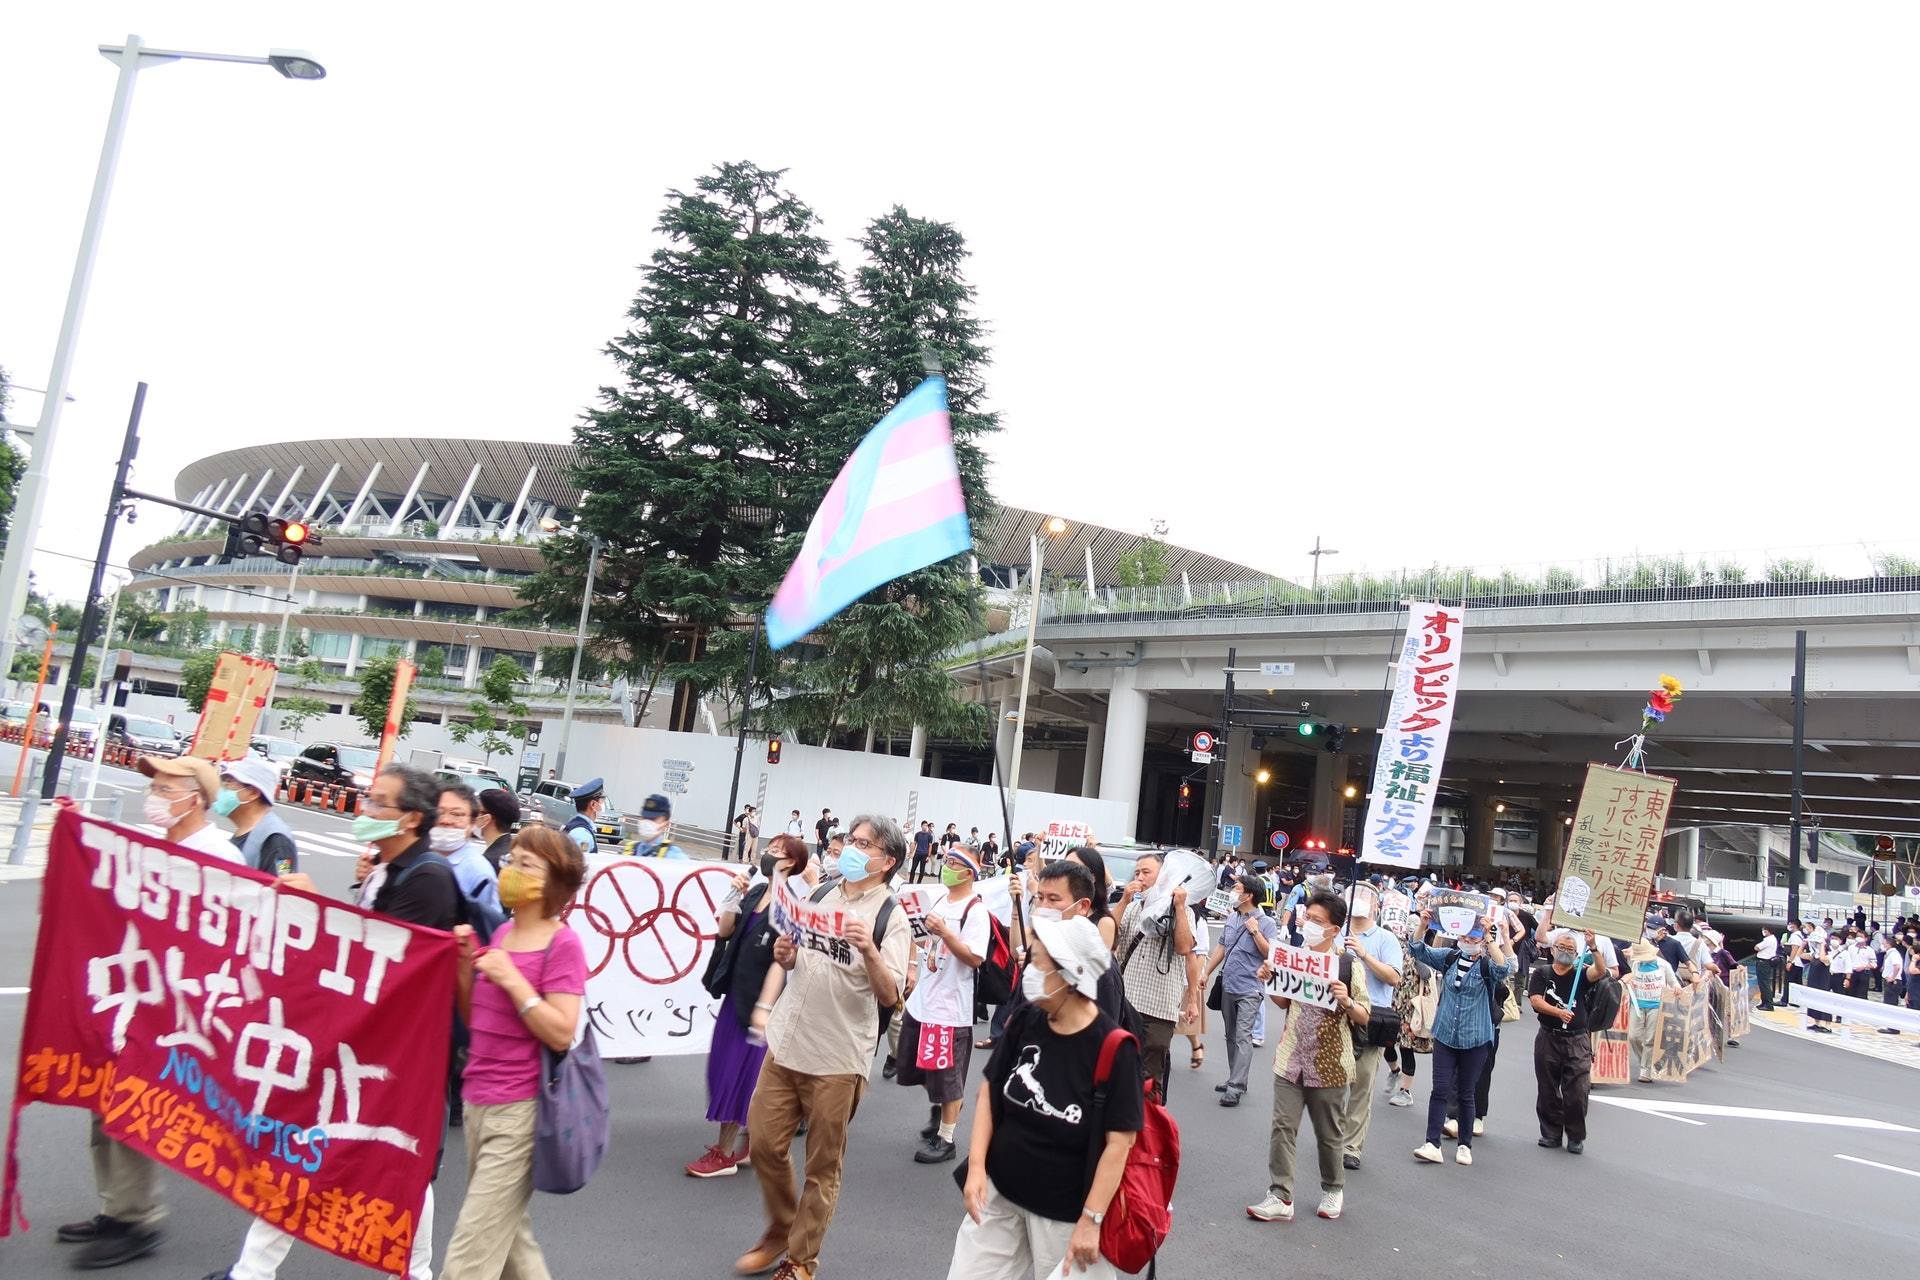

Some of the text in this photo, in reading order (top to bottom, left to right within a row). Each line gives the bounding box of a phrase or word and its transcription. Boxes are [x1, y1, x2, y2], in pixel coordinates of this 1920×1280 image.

[1375, 611, 1460, 858] オリンピックより福祉に力を
[1591, 786, 1629, 889] ゴリンジュウ
[1599, 784, 1646, 914] すでに死に体
[1624, 788, 1668, 910] 東京五輪
[318, 906, 413, 1004] IT
[1273, 947, 1331, 979] 廃止だ!
[162, 1047, 202, 1094] NO
[923, 1033, 935, 1061] We
[936, 1025, 949, 1069] Over
